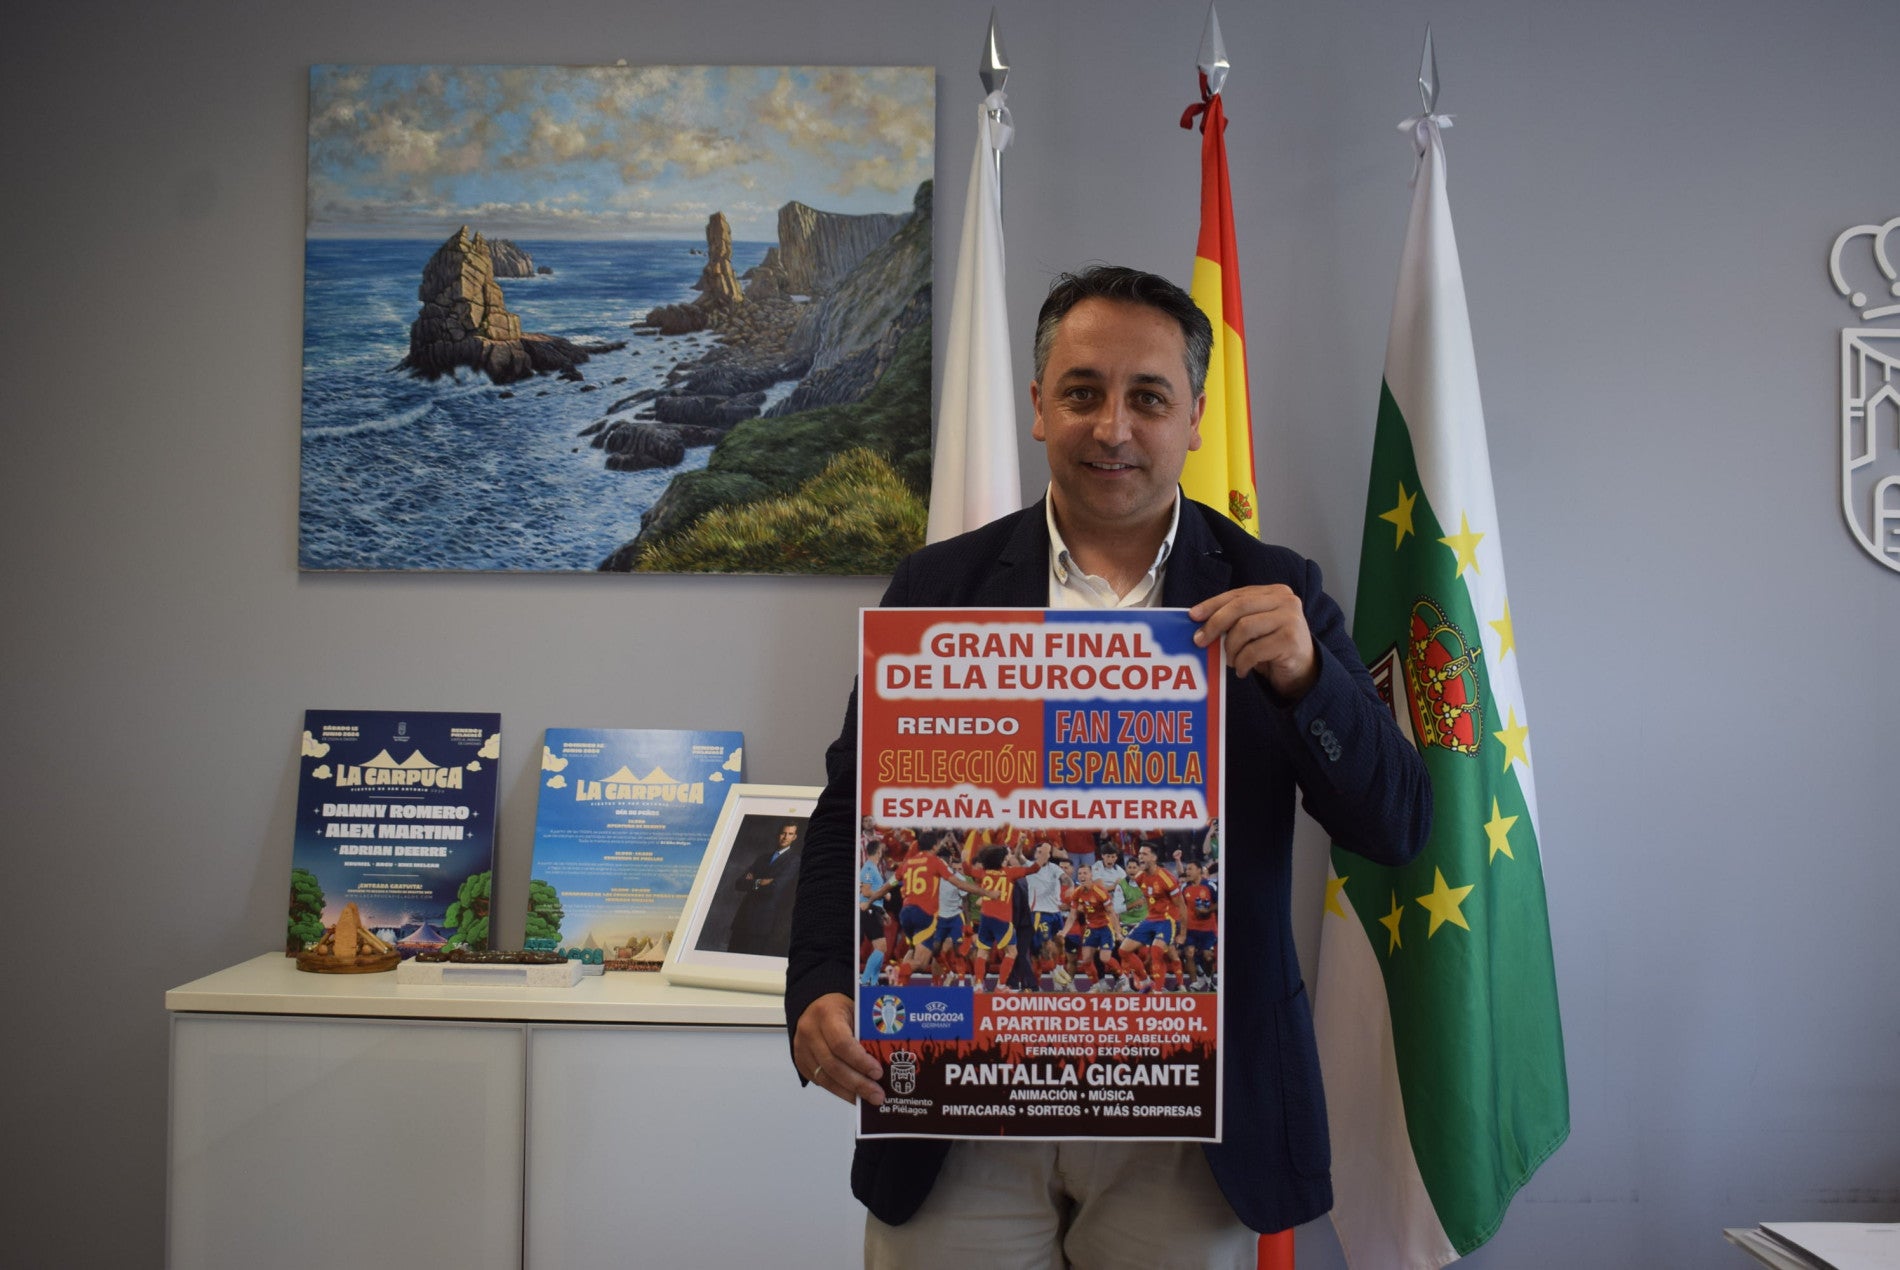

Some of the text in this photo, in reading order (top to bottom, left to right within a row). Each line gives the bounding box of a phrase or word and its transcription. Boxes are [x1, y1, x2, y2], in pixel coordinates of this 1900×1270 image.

[930, 632, 1152, 658] GRAN FINAL
[886, 664, 1198, 691] DE LA EUROCOPA
[897, 717, 1020, 735] RENEDO
[1056, 710, 1193, 744] FAN ZONE
[878, 743, 1203, 785] SELECCIÓN ESPAÑOLA
[336, 763, 463, 790] LA CARPUCA
[576, 779, 704, 805] LA CARPUCA
[322, 803, 470, 820] DANNY ROMERO
[882, 793, 994, 819] ESPAÑA
[1018, 798, 1199, 820] INGLATERRA
[325, 823, 464, 840] ALEX MARTINI
[339, 844, 393, 856] ADRIAN
[903, 866, 928, 895] 16
[981, 876, 1008, 901] 24
[926, 1003, 947, 1012] UEFA
[991, 996, 1196, 1012] DOMINGO 14 DE JULIO
[909, 1012, 964, 1022] EURO2024
[921, 1021, 951, 1029] GERMANY
[979, 1016, 1208, 1032] A PARTIR DE LAS 19:00 H.
[995, 1032, 1191, 1044] APARCAMIENTO DEL PABELLÓN
[1025, 1045, 1160, 1056] FERNANDO EXPÓSITO
[945, 1063, 1200, 1087] PANTALLA GIGANTE
[884, 1097, 933, 1106] untamiento
[1009, 1088, 1135, 1101] ANIMACIÓN MÚSICA
[880, 1103, 928, 1116] de Piélagos
[942, 1103, 1202, 1117] PINTACARAS SORTEOS Y MÁS SORPRESAS
